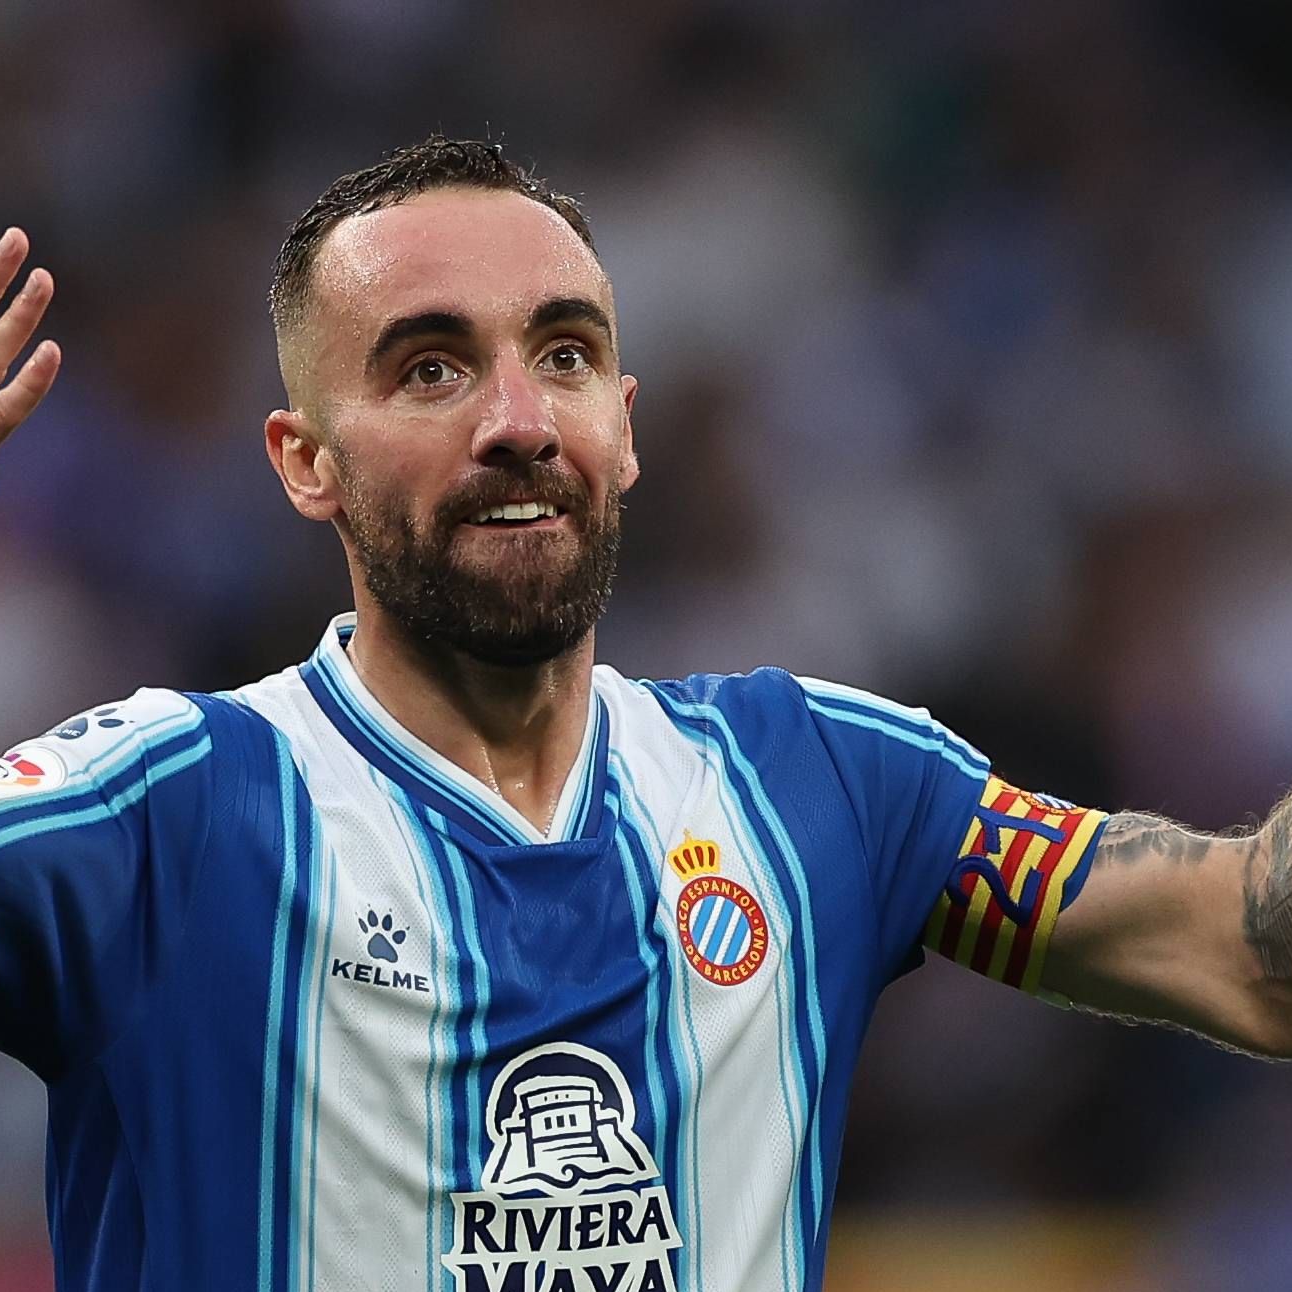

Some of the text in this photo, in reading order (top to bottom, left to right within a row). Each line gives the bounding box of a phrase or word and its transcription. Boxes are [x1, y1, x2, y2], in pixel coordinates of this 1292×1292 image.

[679, 881, 756, 933] RCD ESPANYOL
[331, 958, 430, 993] KELME
[686, 925, 765, 982] DE BARCELONA
[460, 1196, 671, 1256] RIVIERA
